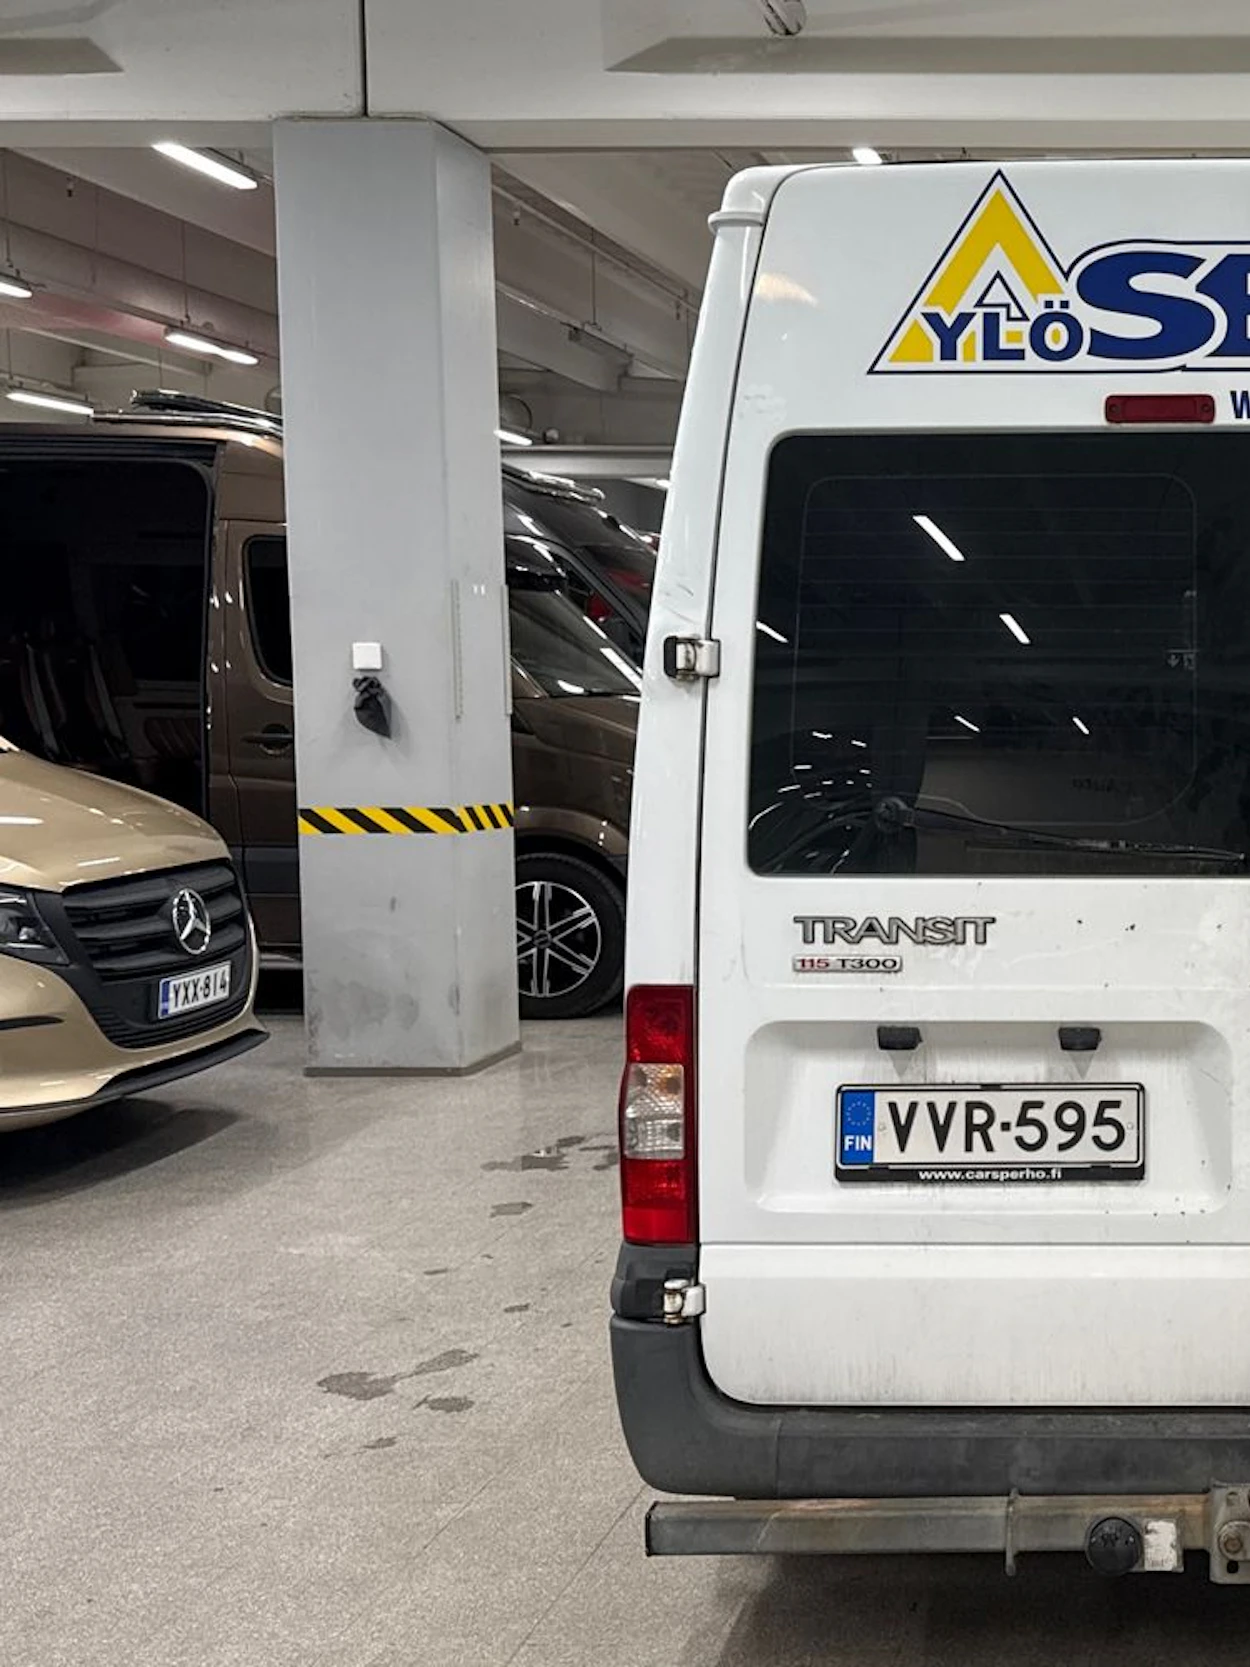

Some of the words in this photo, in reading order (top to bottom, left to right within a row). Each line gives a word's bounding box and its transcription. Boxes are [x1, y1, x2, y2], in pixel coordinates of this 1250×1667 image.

[793, 916, 996, 945] TRANSIT
[797, 958, 830, 969] 115
[836, 958, 898, 970] T300
[173, 970, 227, 1008] YXX-814
[844, 1135, 872, 1151] FIN
[888, 1100, 1126, 1153] VVR-595
[918, 1168, 1063, 1182] www.carsperho.fi
